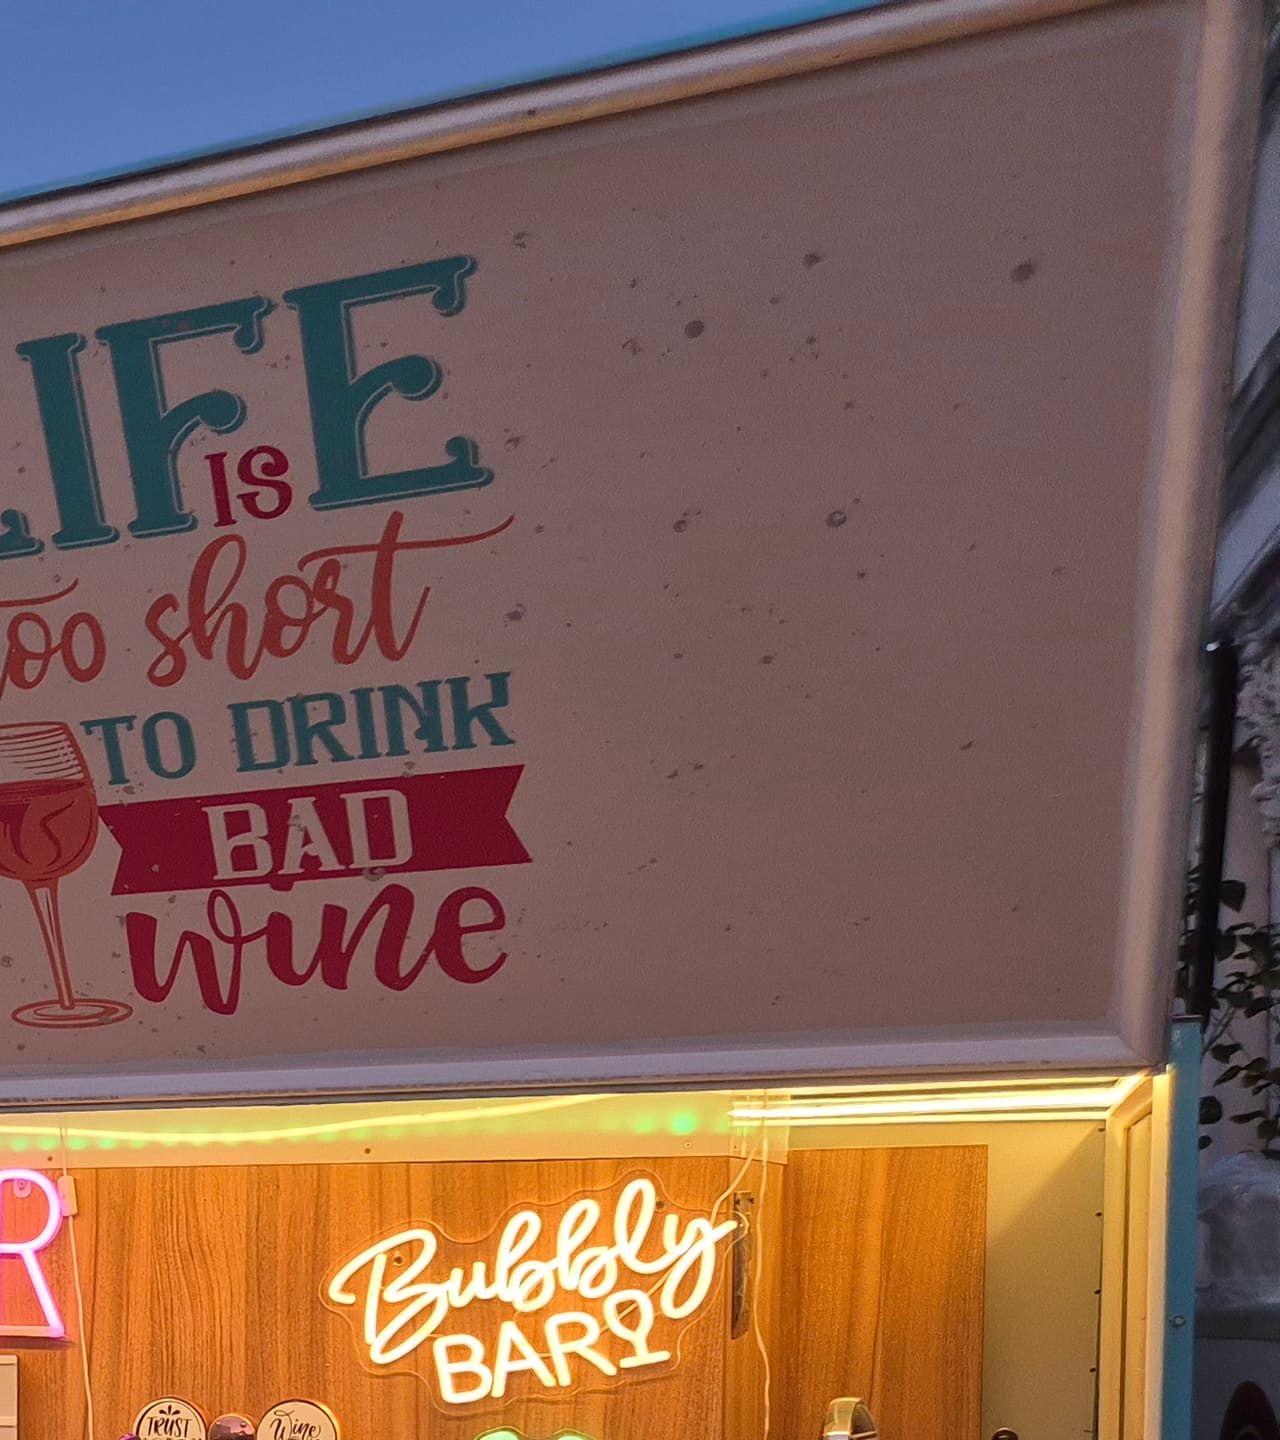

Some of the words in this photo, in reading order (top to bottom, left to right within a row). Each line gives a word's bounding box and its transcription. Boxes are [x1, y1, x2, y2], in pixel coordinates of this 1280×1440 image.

[203, 445, 293, 527] IS
[144, 511, 515, 687] short
[80, 711, 197, 785] TO
[227, 671, 517, 774] DRINK
[202, 788, 414, 882] BAD
[126, 884, 509, 1015] wine
[328, 1178, 738, 1366] Bubbly
[432, 1311, 617, 1405] BAR
[147, 1416, 193, 1438] TRUST
